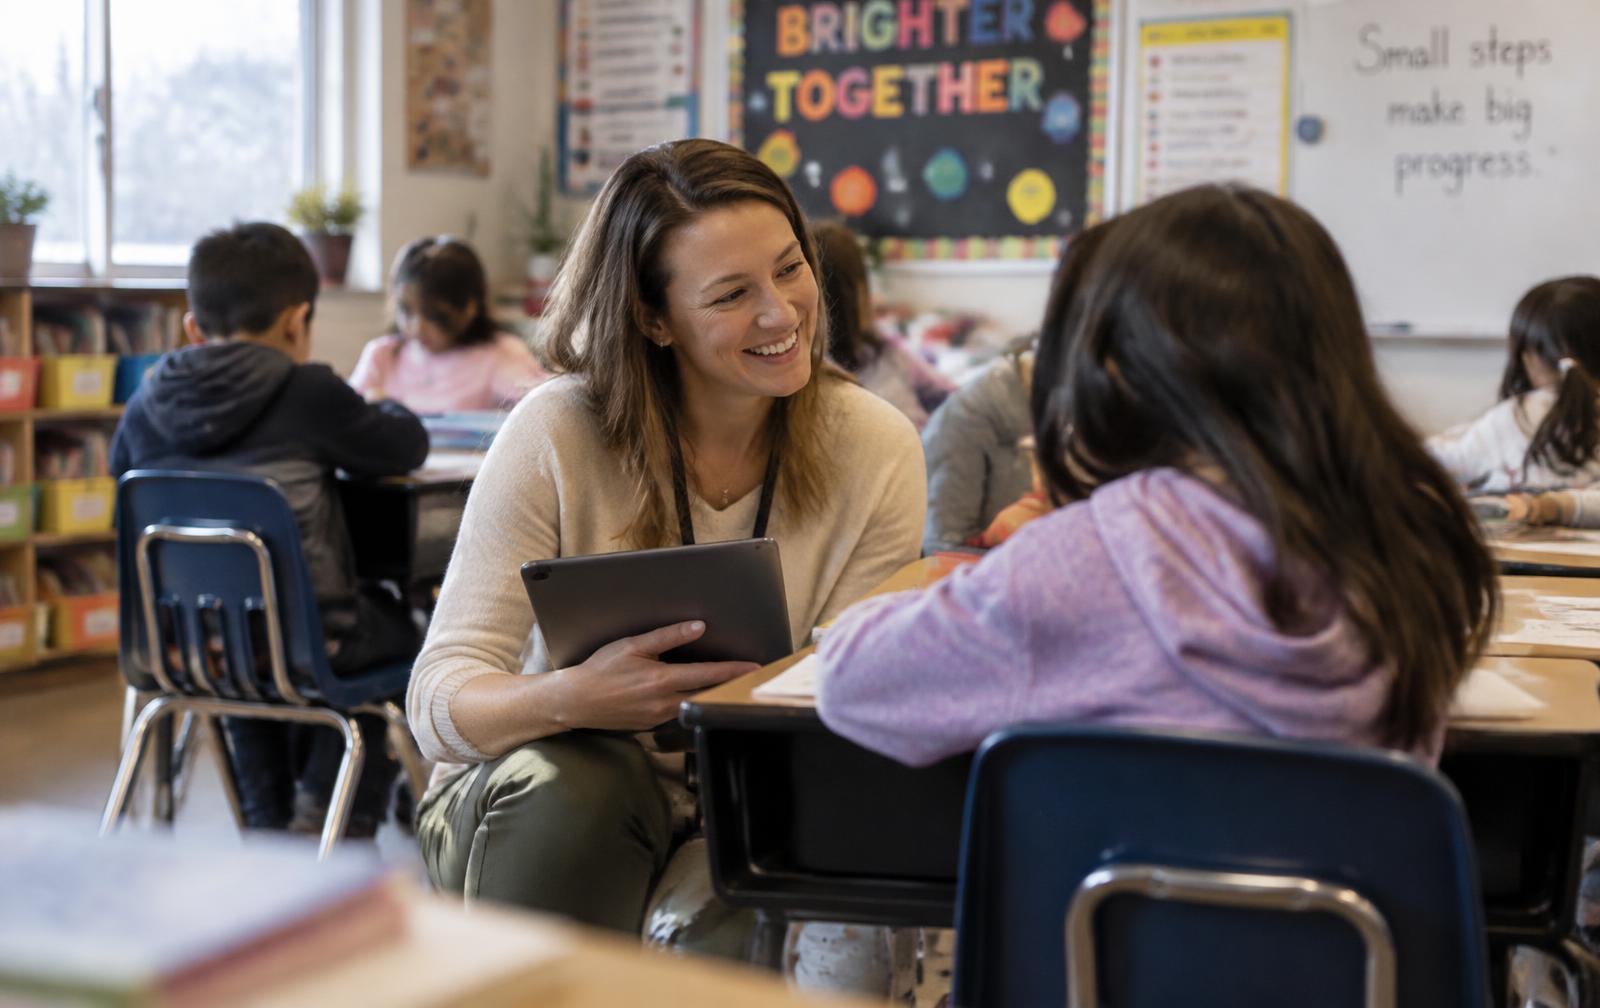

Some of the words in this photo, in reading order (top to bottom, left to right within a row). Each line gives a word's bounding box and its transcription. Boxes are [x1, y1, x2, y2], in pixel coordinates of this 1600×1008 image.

[776, 0, 1034, 57] BRIGHTER
[1354, 22, 1450, 77] Small
[1469, 23, 1552, 79] steps
[765, 57, 1044, 123] TOGETHER
[1386, 86, 1465, 125] make
[1486, 84, 1533, 141] big
